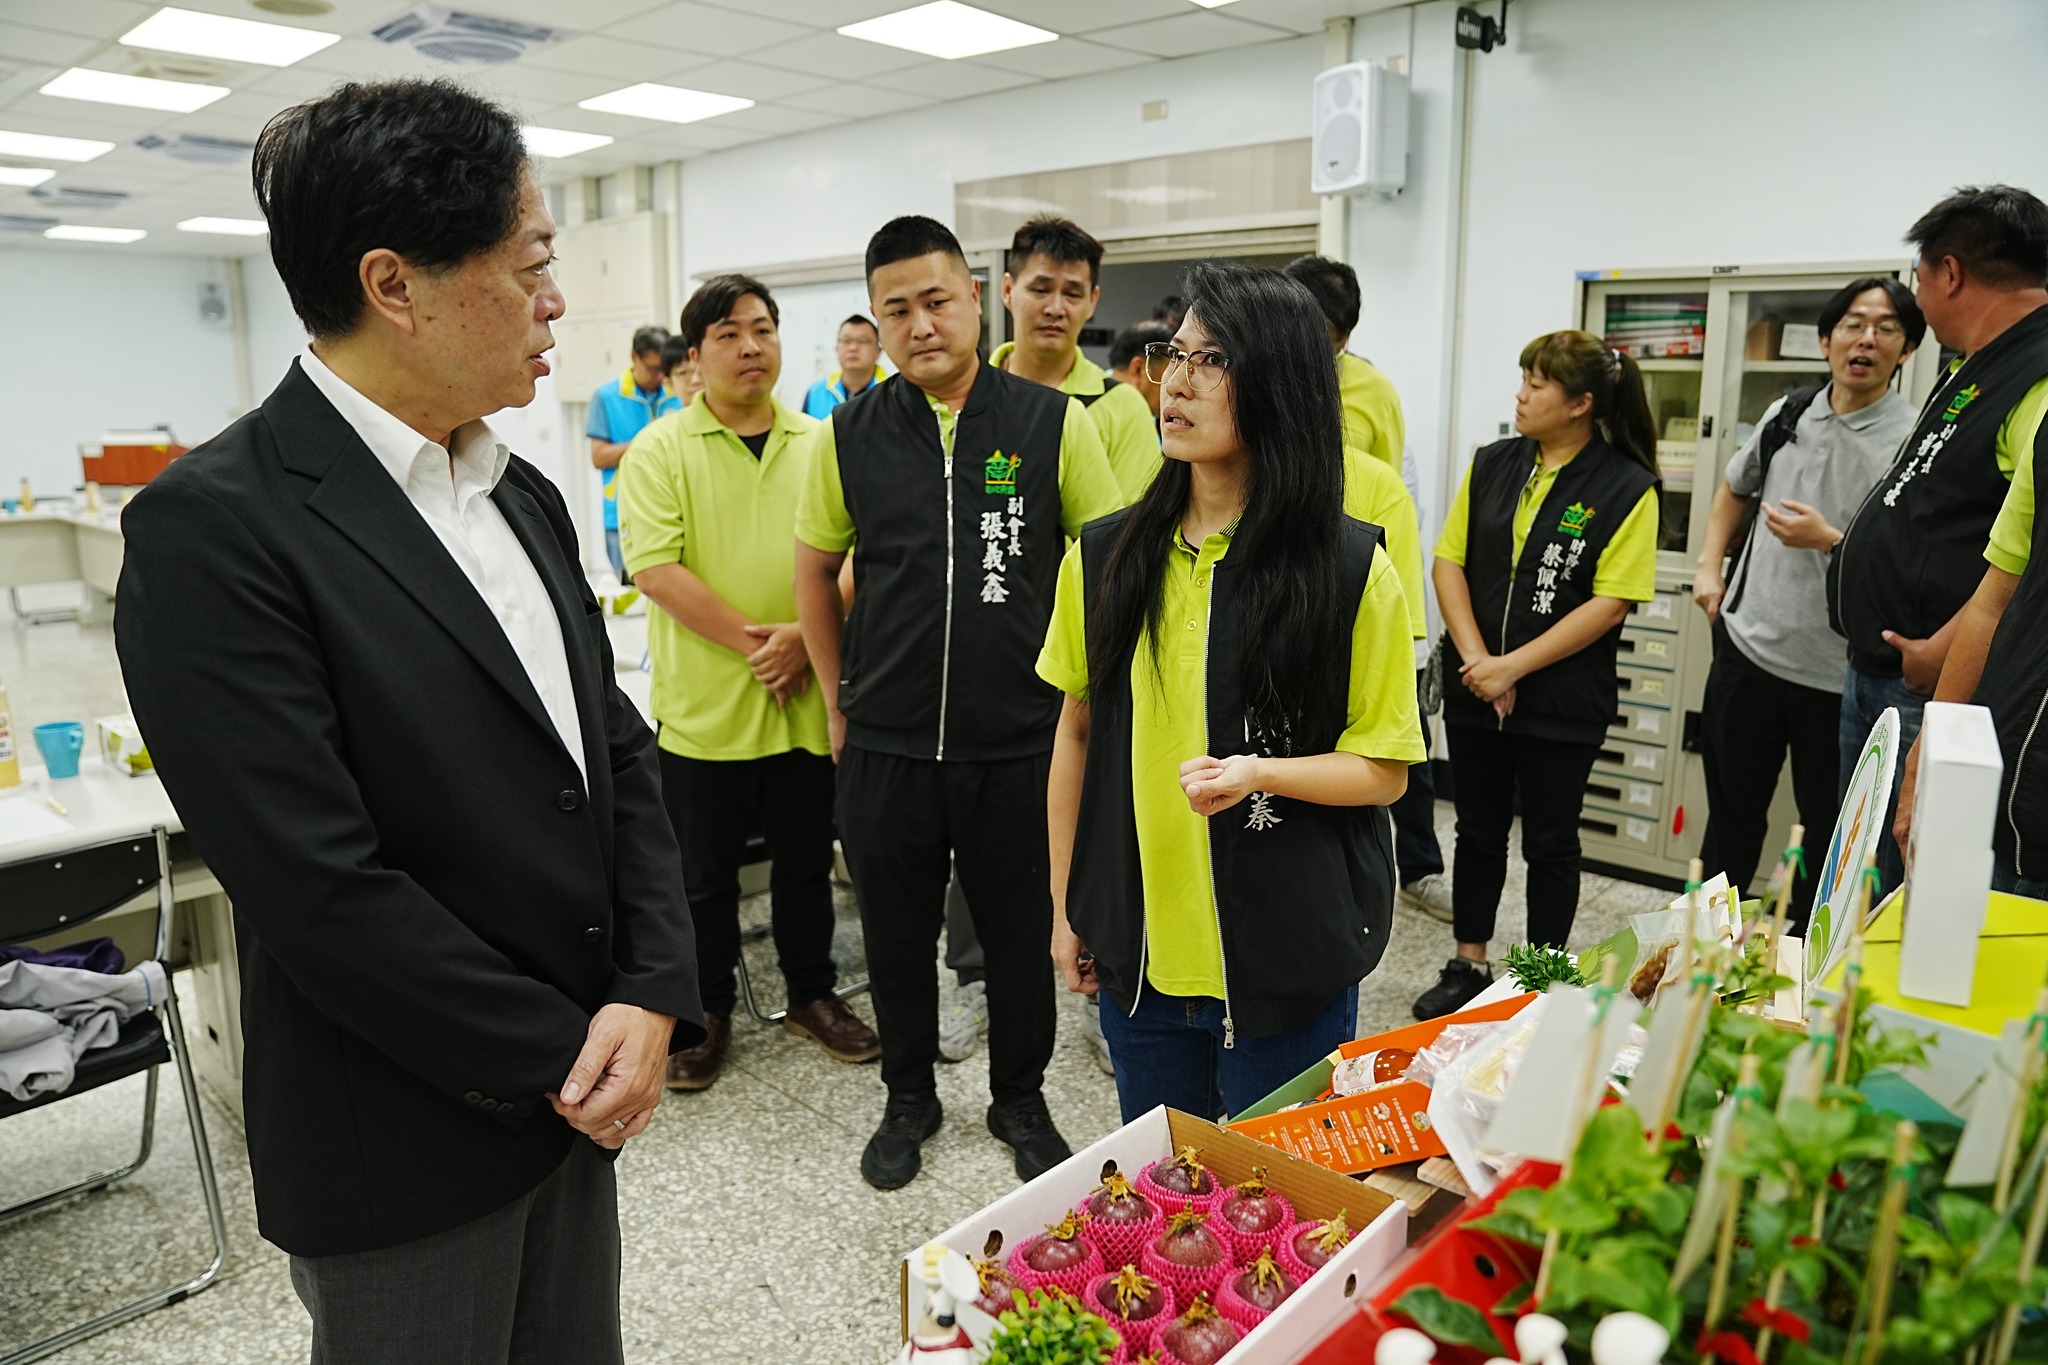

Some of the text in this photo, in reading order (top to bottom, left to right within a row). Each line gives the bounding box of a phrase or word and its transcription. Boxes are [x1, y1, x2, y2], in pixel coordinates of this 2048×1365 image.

[980, 511, 1010, 603] 張義鑫
[1006, 495, 1026, 557] 副會長
